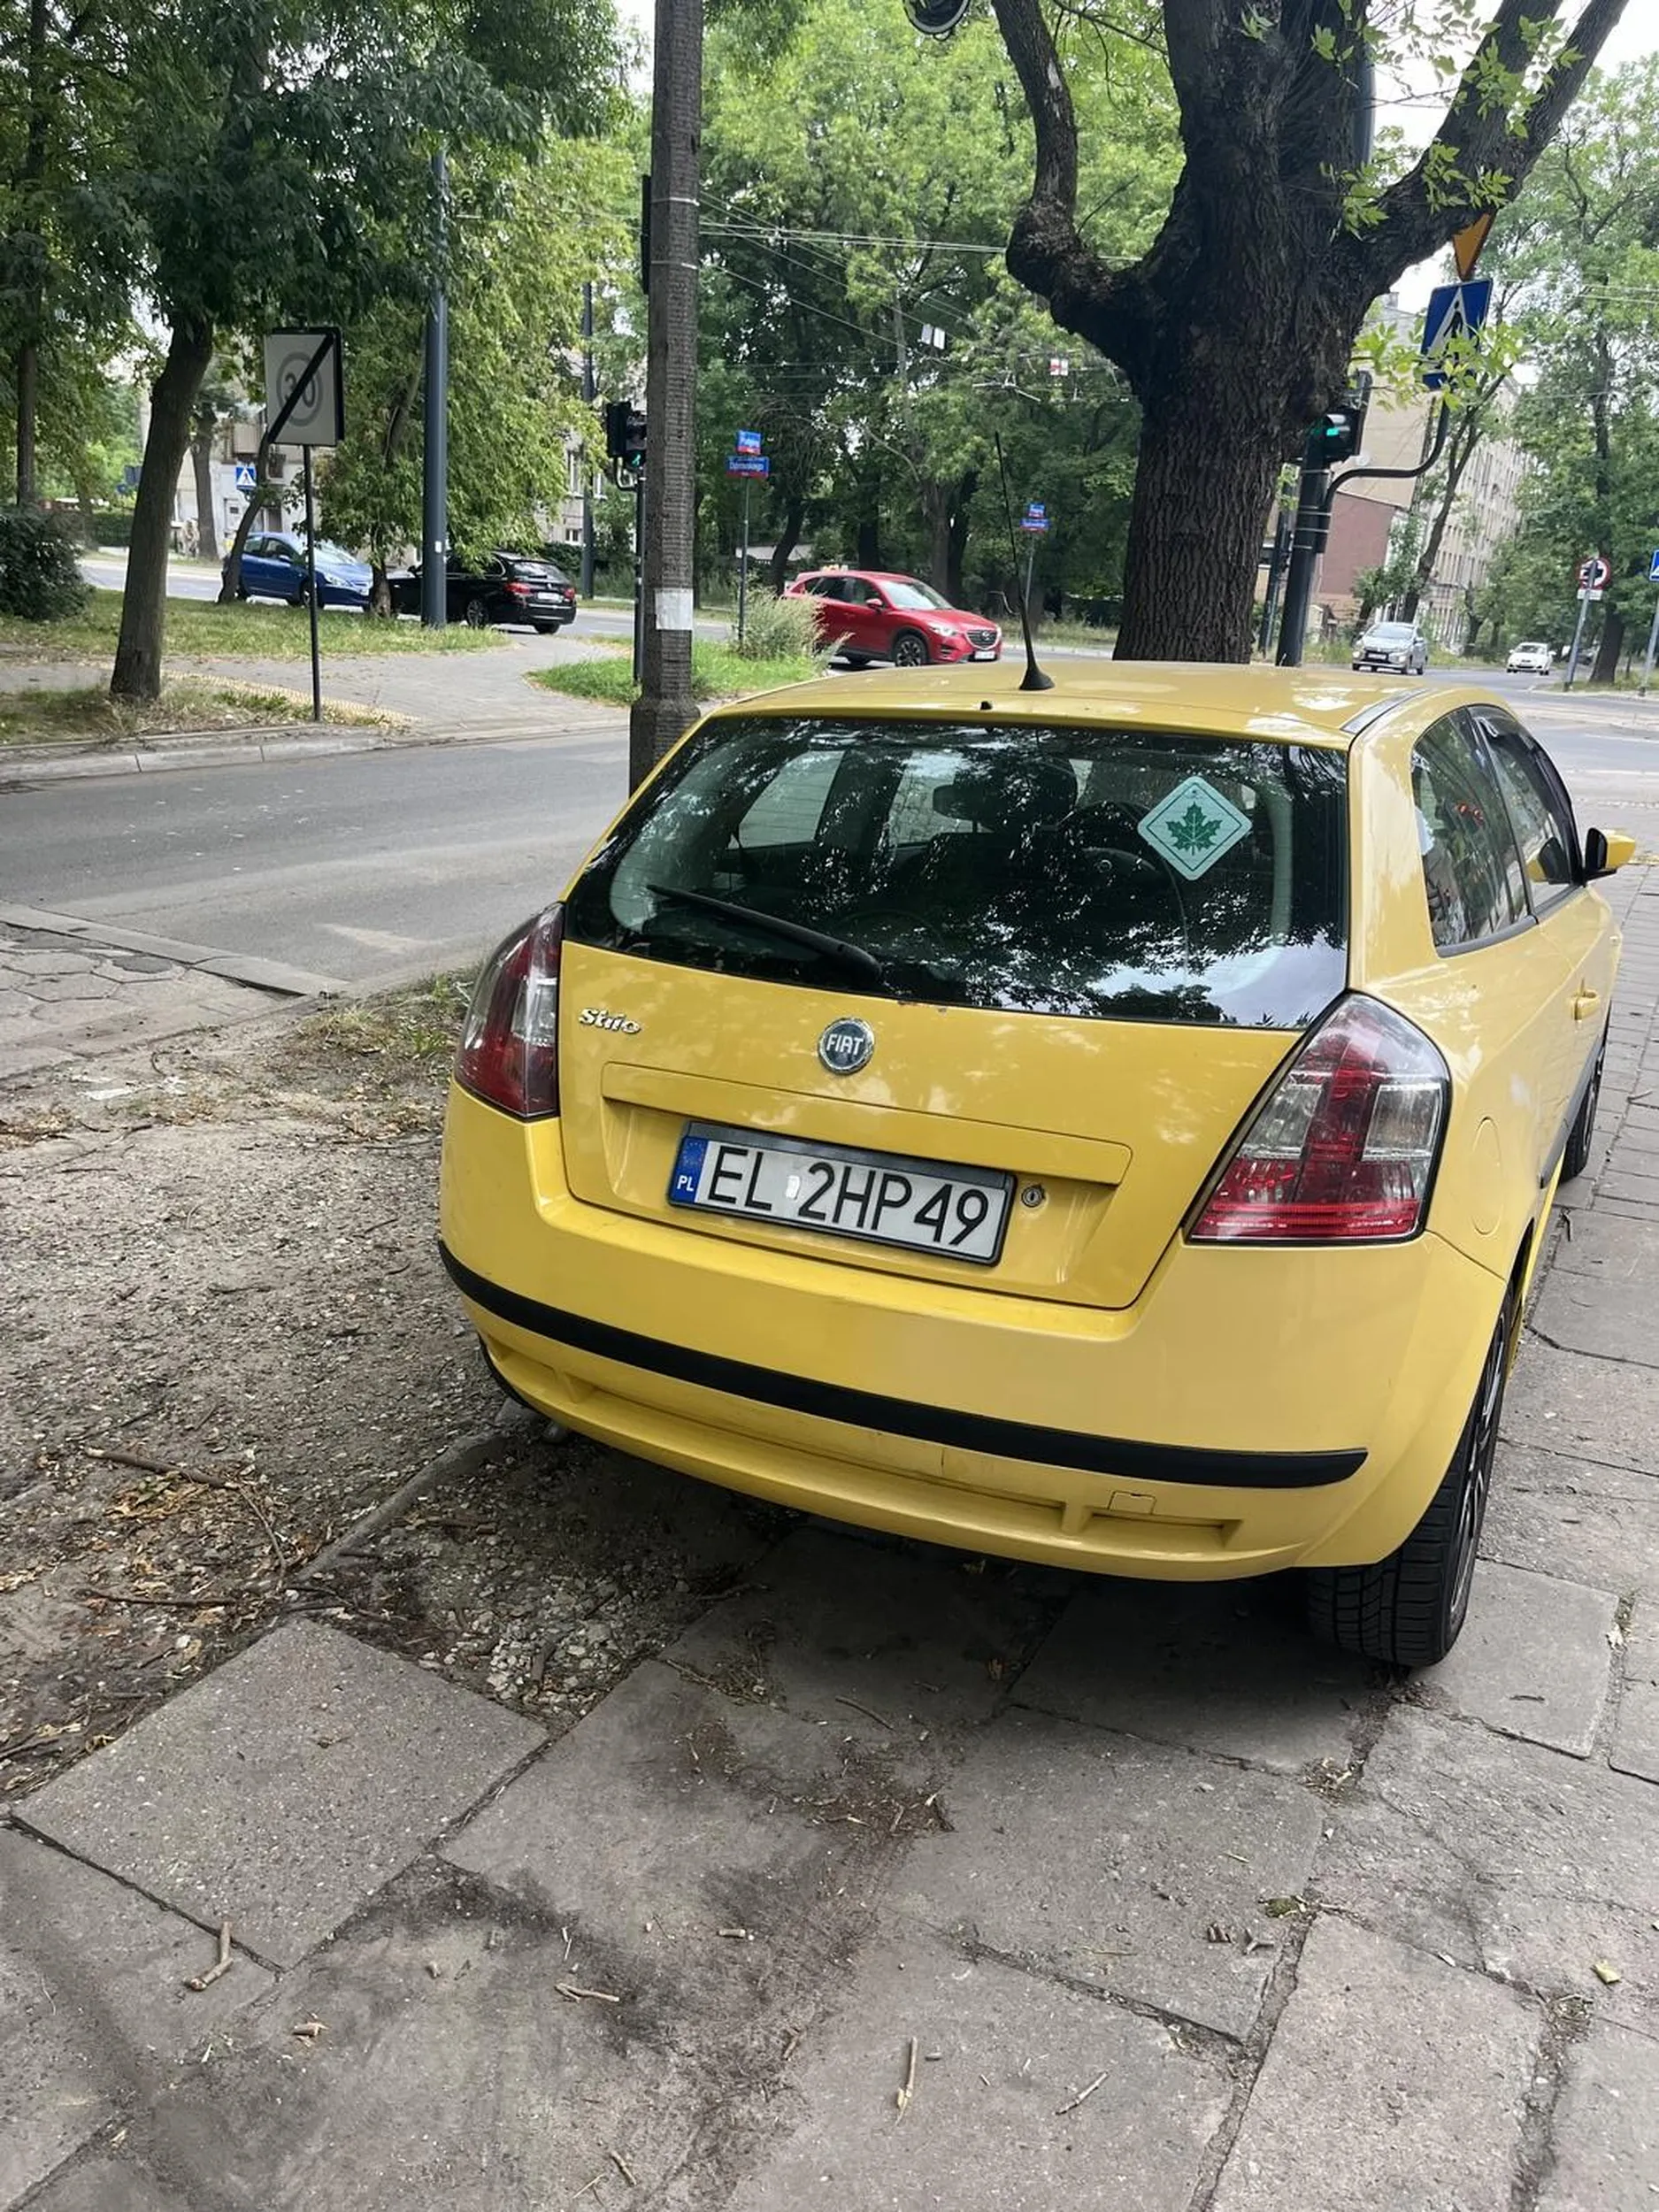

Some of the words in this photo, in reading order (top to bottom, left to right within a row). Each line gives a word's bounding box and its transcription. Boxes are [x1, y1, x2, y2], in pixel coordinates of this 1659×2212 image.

[284, 372, 316, 408] 30
[826, 1033, 864, 1056] FIAT
[677, 1174, 695, 1192] PL
[708, 1145, 772, 1212] EL
[797, 1162, 989, 1246] 2HP49
